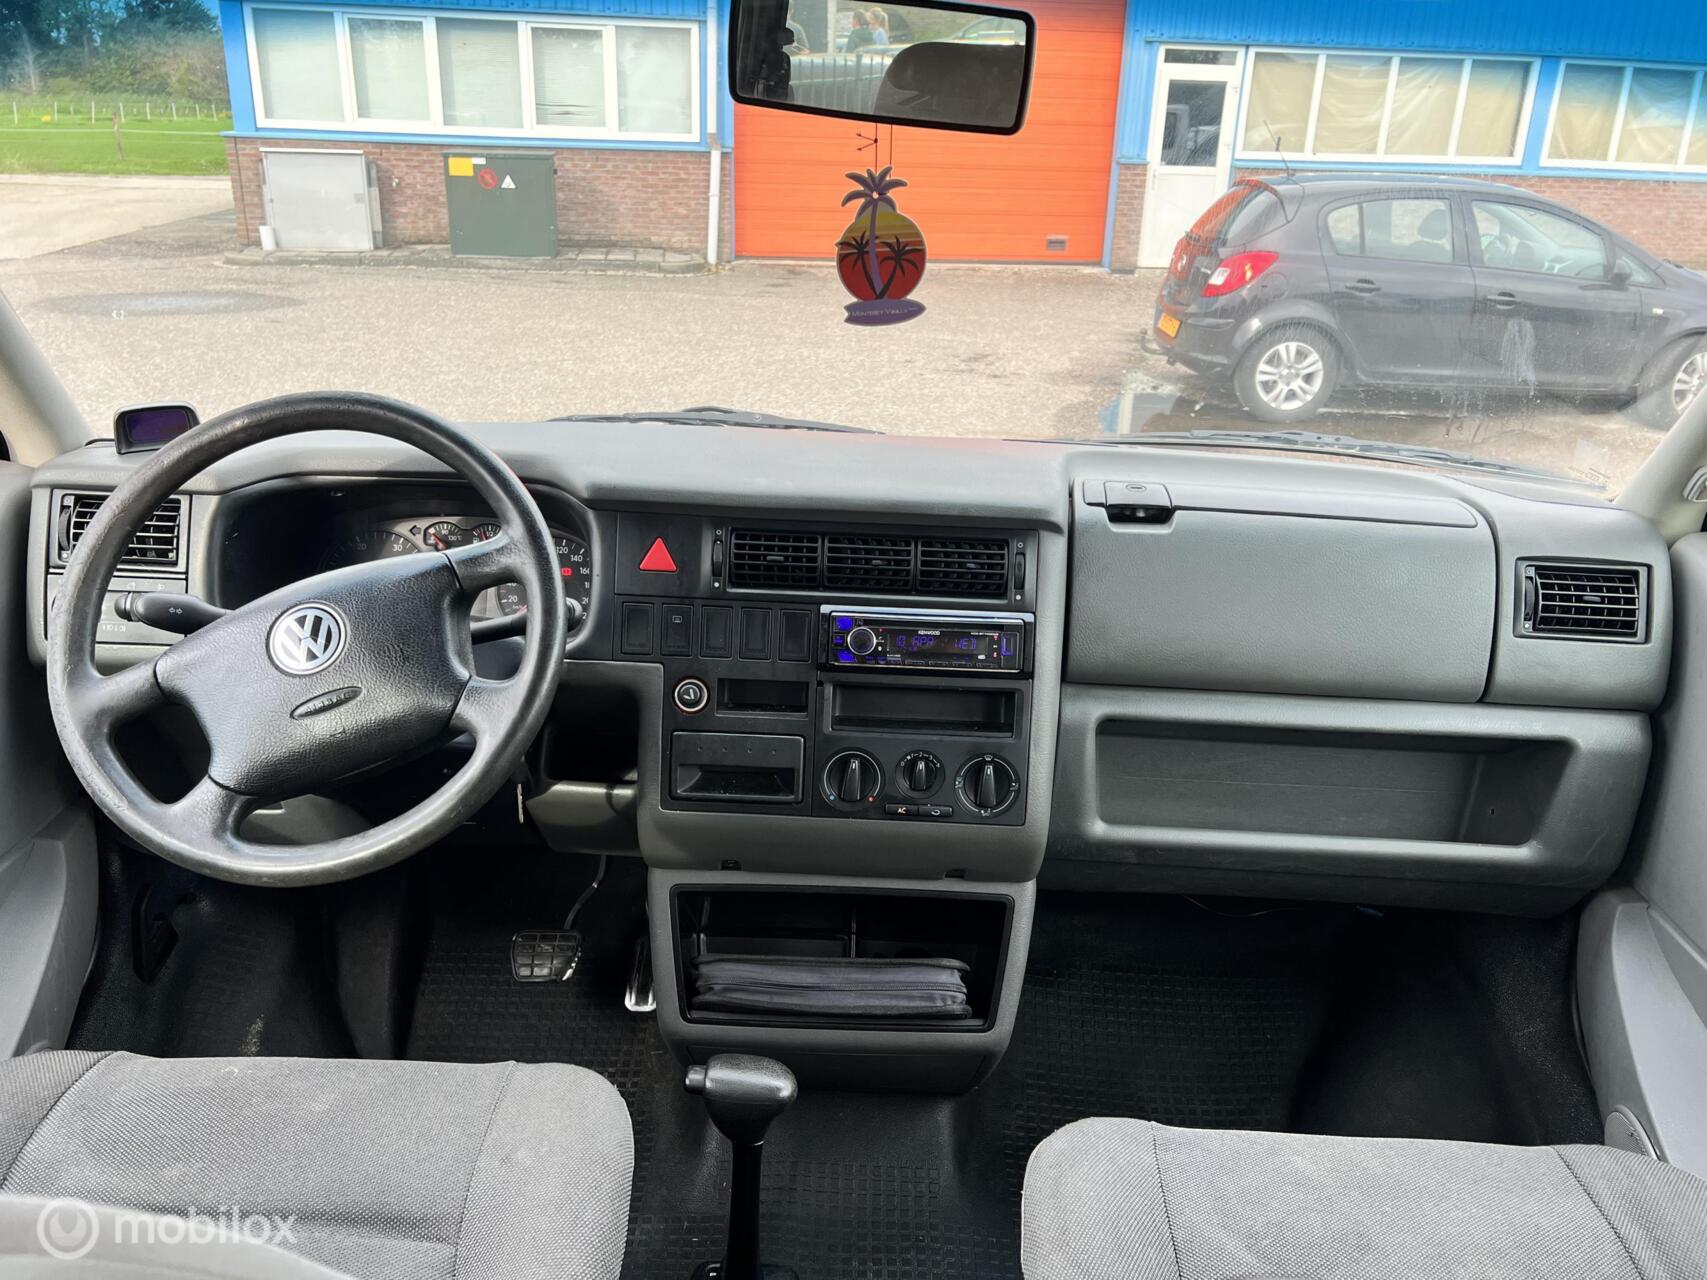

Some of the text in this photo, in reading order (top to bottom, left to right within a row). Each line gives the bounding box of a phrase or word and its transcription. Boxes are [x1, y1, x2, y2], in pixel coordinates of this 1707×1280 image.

[392, 544, 403, 552] 30
[556, 546, 569, 554] 120
[570, 554, 583, 562] 140
